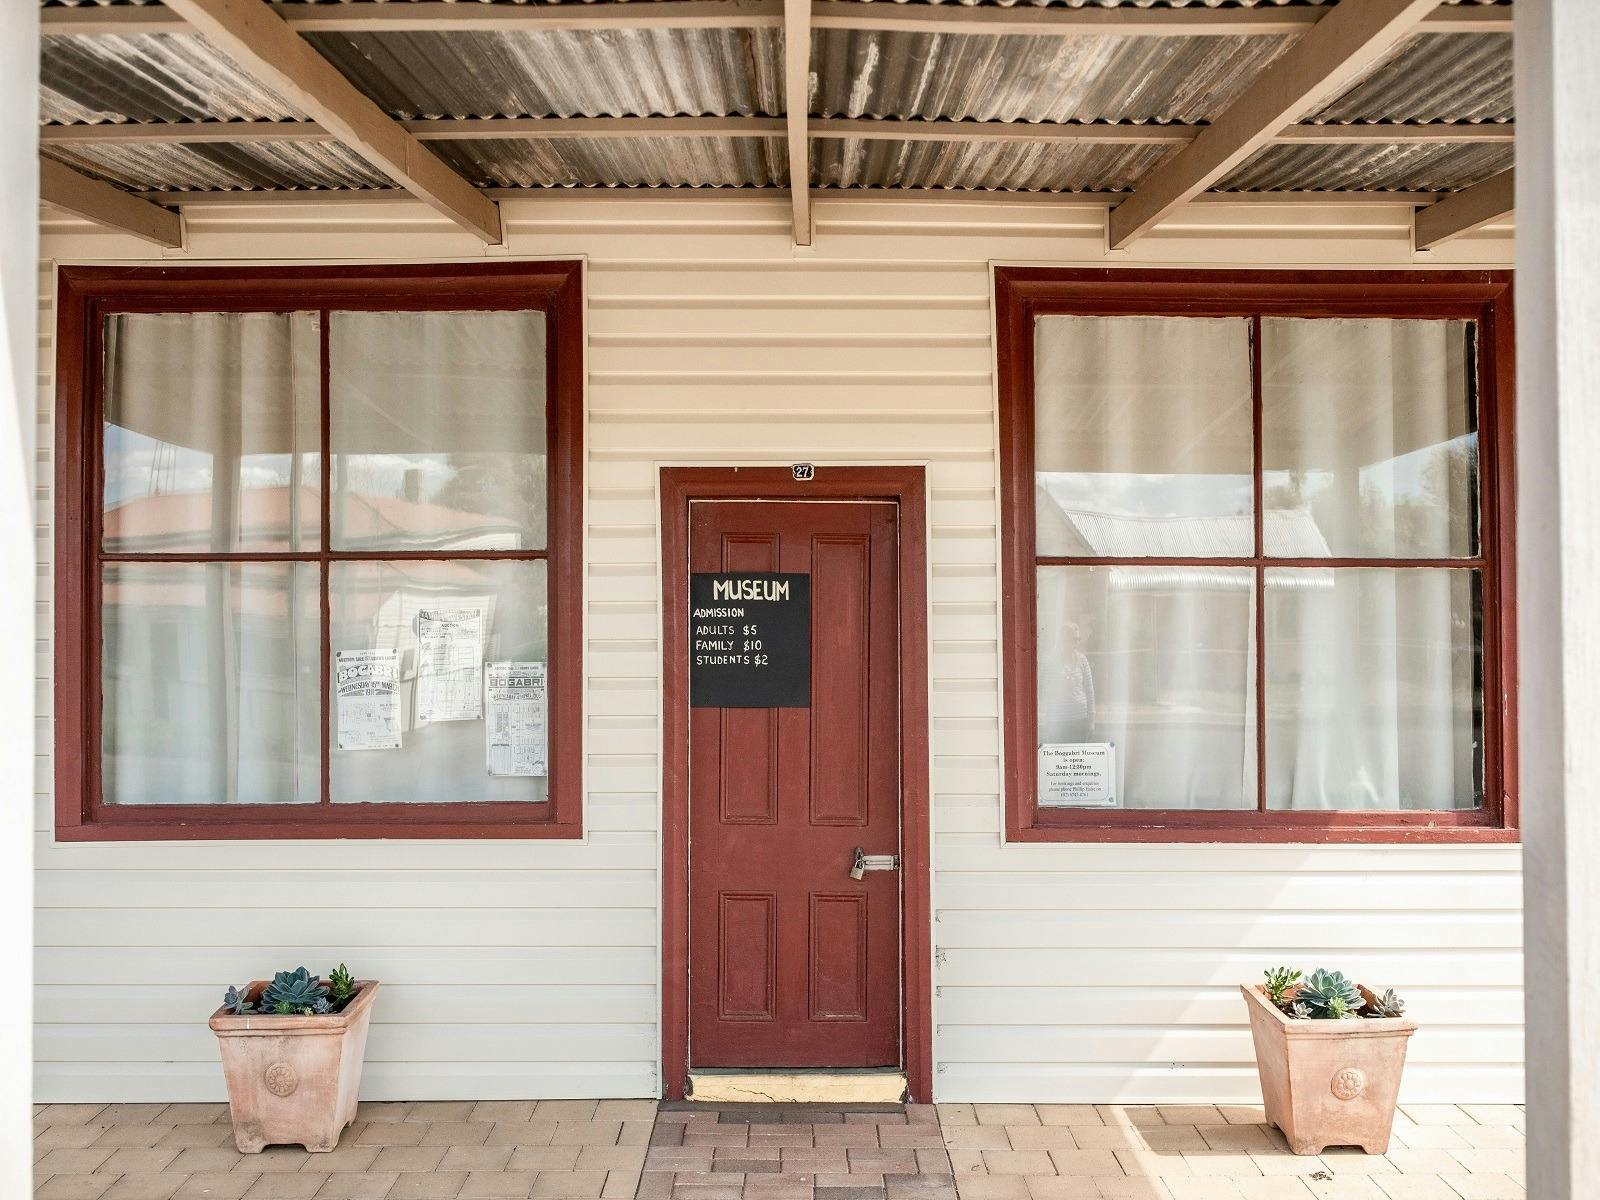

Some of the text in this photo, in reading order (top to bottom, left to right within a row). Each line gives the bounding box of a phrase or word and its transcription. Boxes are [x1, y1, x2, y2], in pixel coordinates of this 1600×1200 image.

[796, 466, 809, 478] 27
[713, 579, 790, 602] MUSEUM
[693, 607, 744, 618] ADMISSION
[696, 624, 758, 636] ADULTS $5
[695, 639, 762, 652] FAMILY $10
[696, 654, 769, 667] STUDENTS $2
[489, 678, 544, 687] BOGABRI
